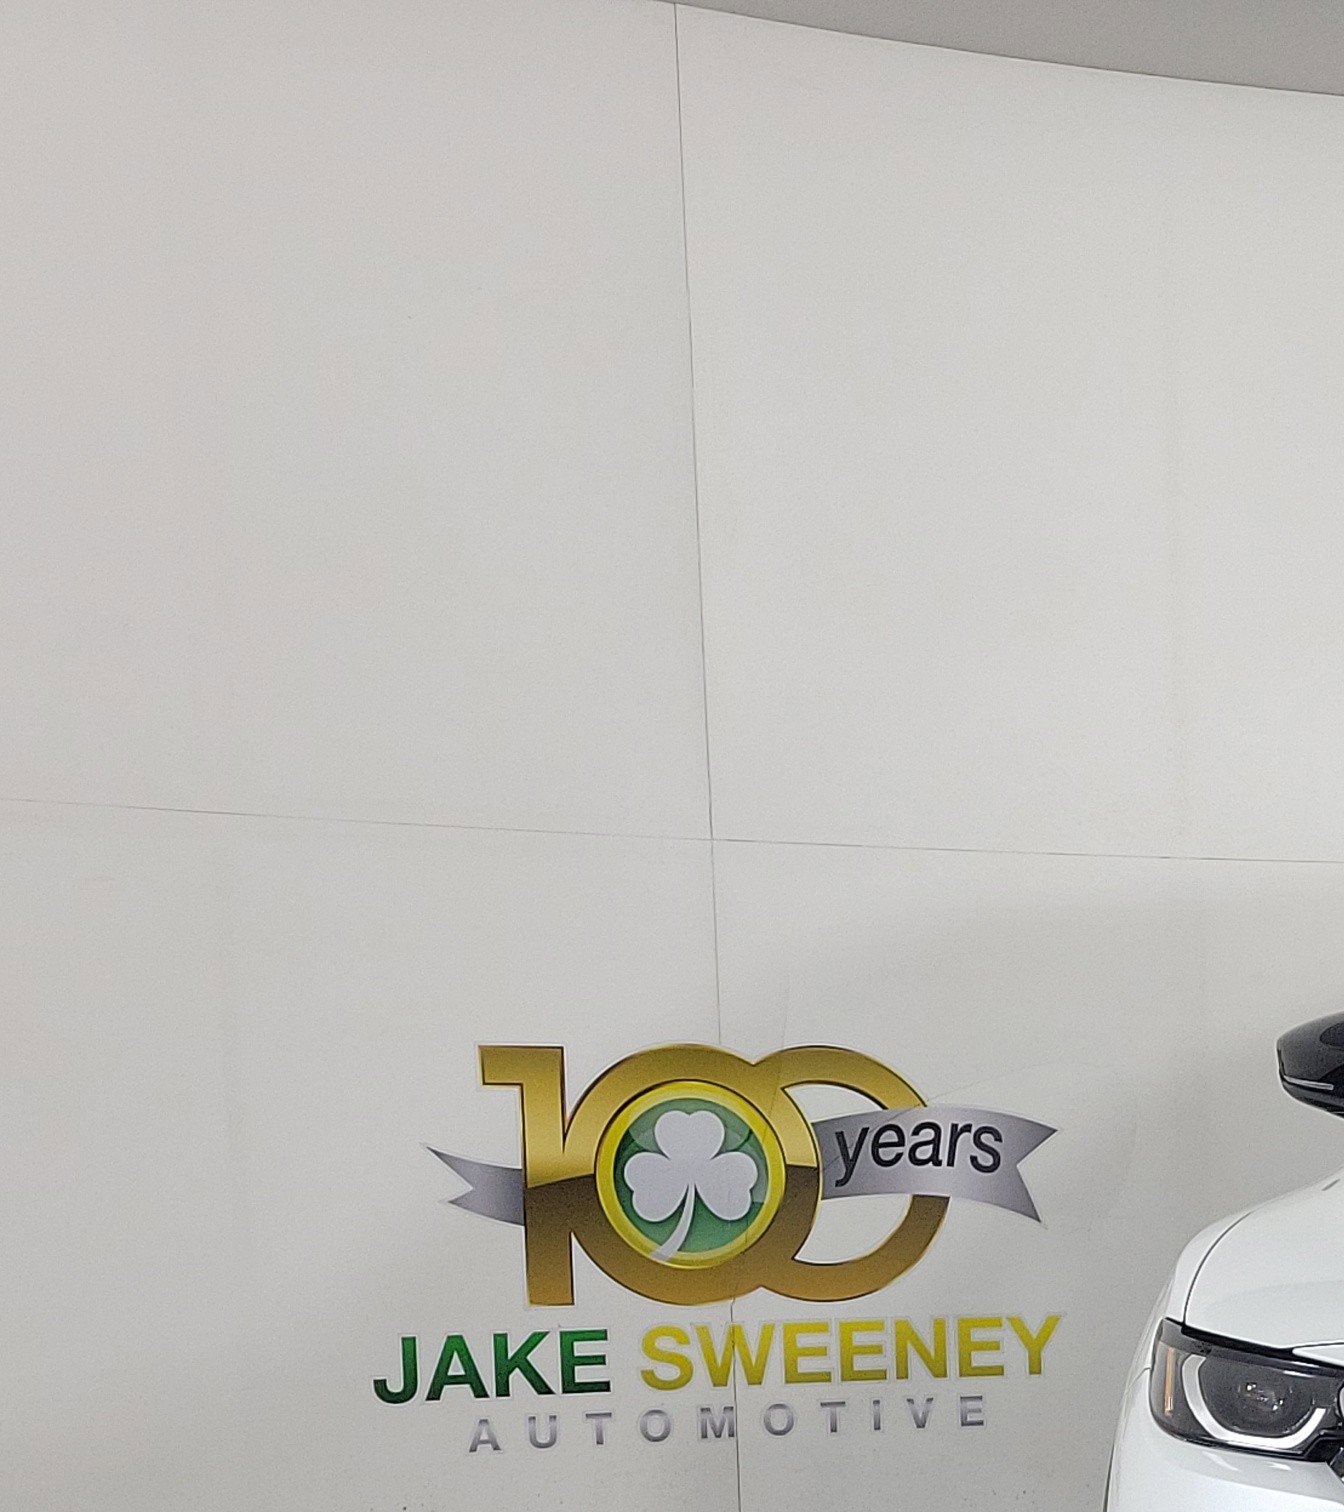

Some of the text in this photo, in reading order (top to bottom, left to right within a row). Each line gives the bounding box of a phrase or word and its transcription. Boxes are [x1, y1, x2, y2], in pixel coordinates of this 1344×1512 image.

[478, 1043, 1002, 1307] 100 years
[372, 1313, 1062, 1405] JAKE SWEENEY
[468, 1395, 985, 1454] AUTOMOTIVE
